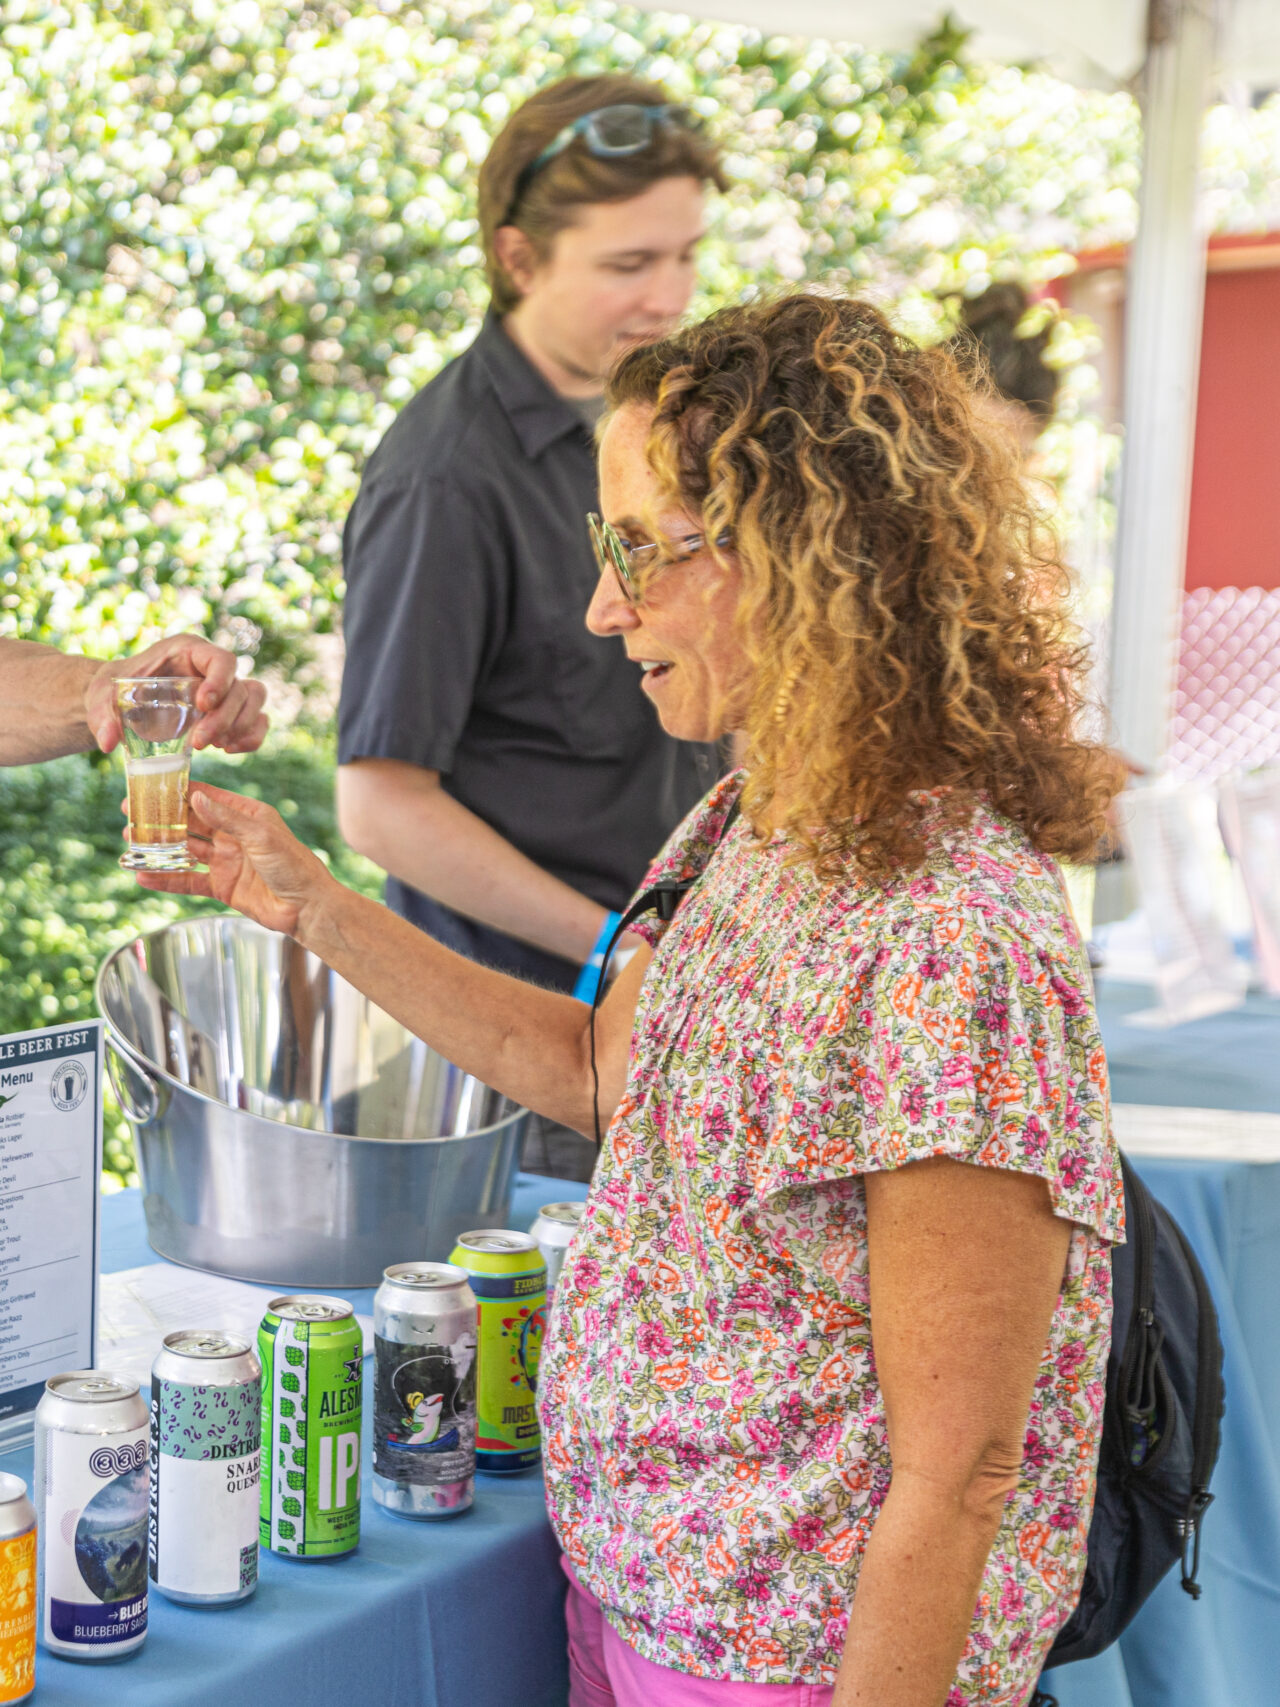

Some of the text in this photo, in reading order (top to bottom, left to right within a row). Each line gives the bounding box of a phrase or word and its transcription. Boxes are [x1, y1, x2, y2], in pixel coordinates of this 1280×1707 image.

[19, 1038, 53, 1056] BEER
[57, 1031, 89, 1049] FEST
[1, 1072, 33, 1088] Menu
[2, 1174, 17, 1184] Devil
[0, 1194, 25, 1206] Questions
[319, 1383, 362, 1419] ALESM
[502, 1402, 537, 1425] MAST
[211, 1432, 260, 1460] DISTRIC
[227, 1453, 260, 1479] SNAR
[318, 1431, 362, 1511] IP
[227, 1470, 260, 1493] QUEST
[120, 1600, 142, 1621] BLUE
[74, 1611, 148, 1637] BLUEBERRY SAIS
